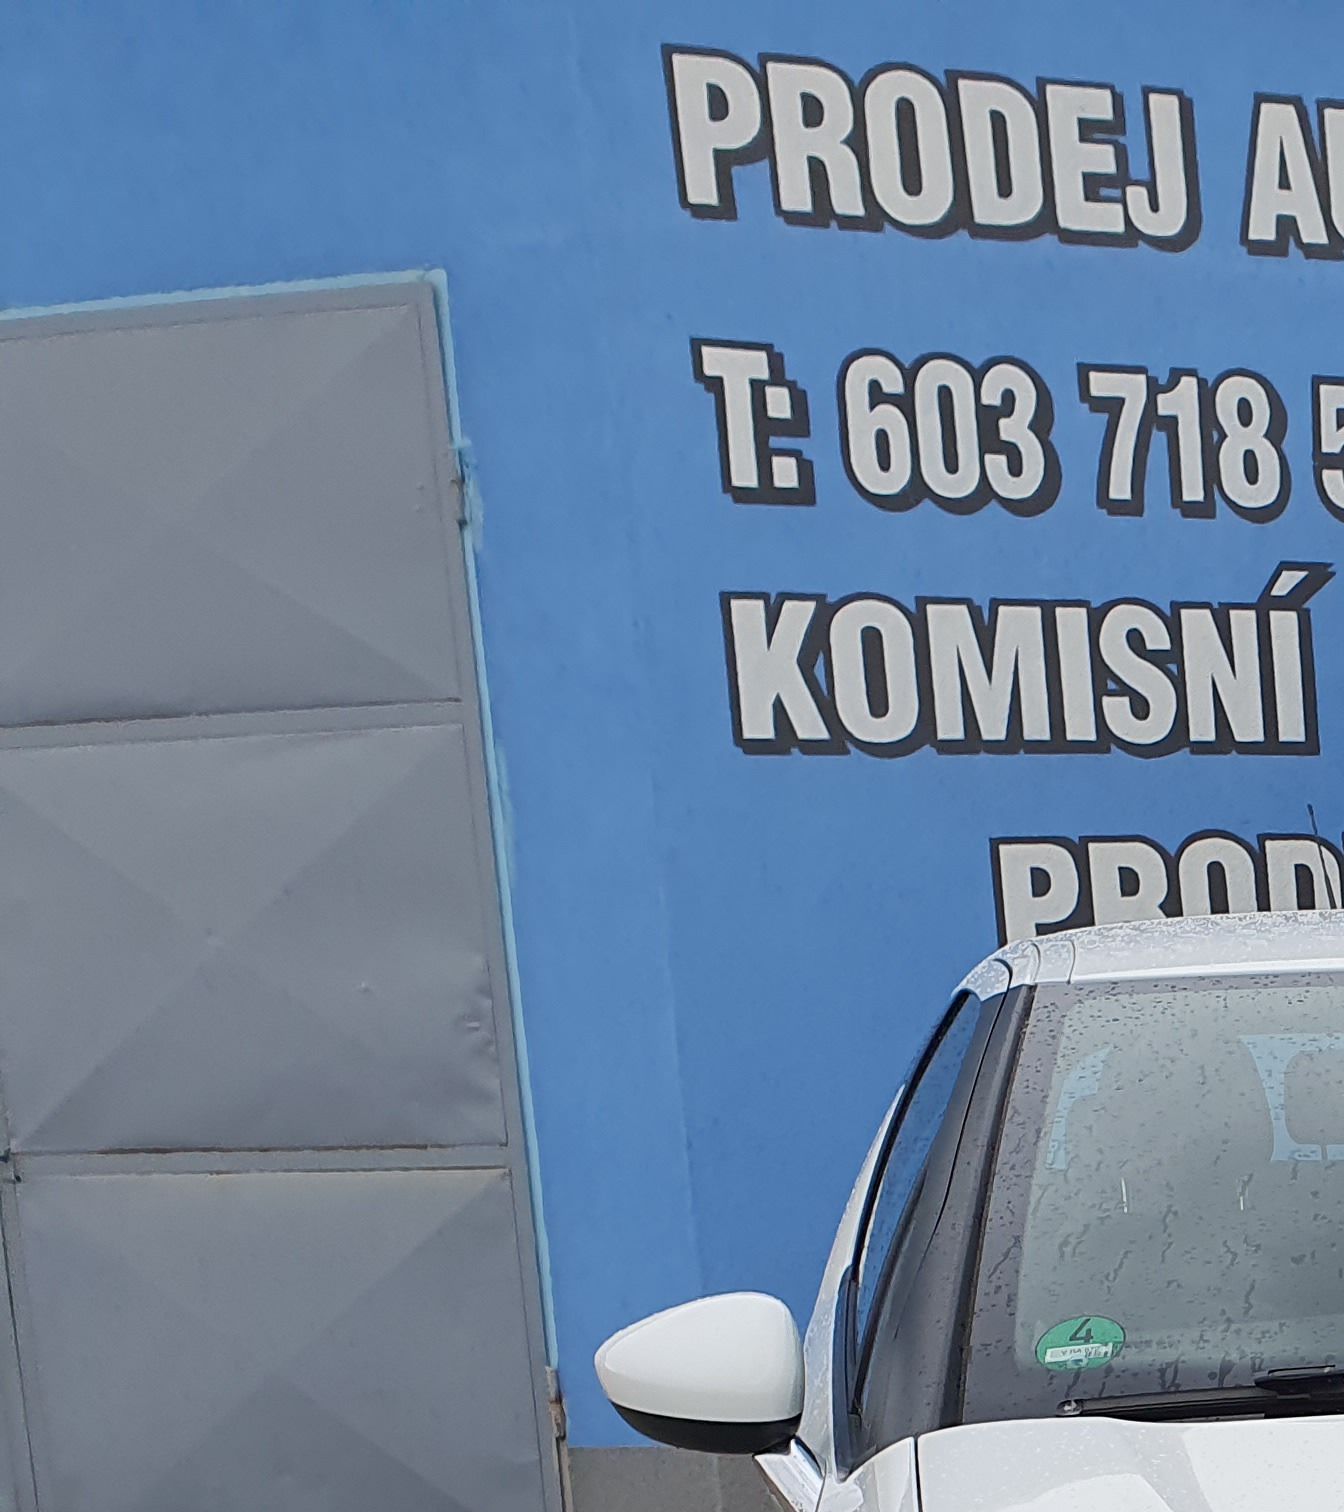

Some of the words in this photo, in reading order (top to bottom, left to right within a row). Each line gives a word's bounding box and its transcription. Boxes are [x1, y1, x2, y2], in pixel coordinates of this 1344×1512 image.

[661, 43, 1201, 252] PRODEJ
[690, 336, 813, 506] T:
[838, 346, 1057, 515] 603
[1078, 360, 1288, 524] 718
[719, 560, 1335, 756] KOMISNÍ
[1069, 1318, 1093, 1343] 4
